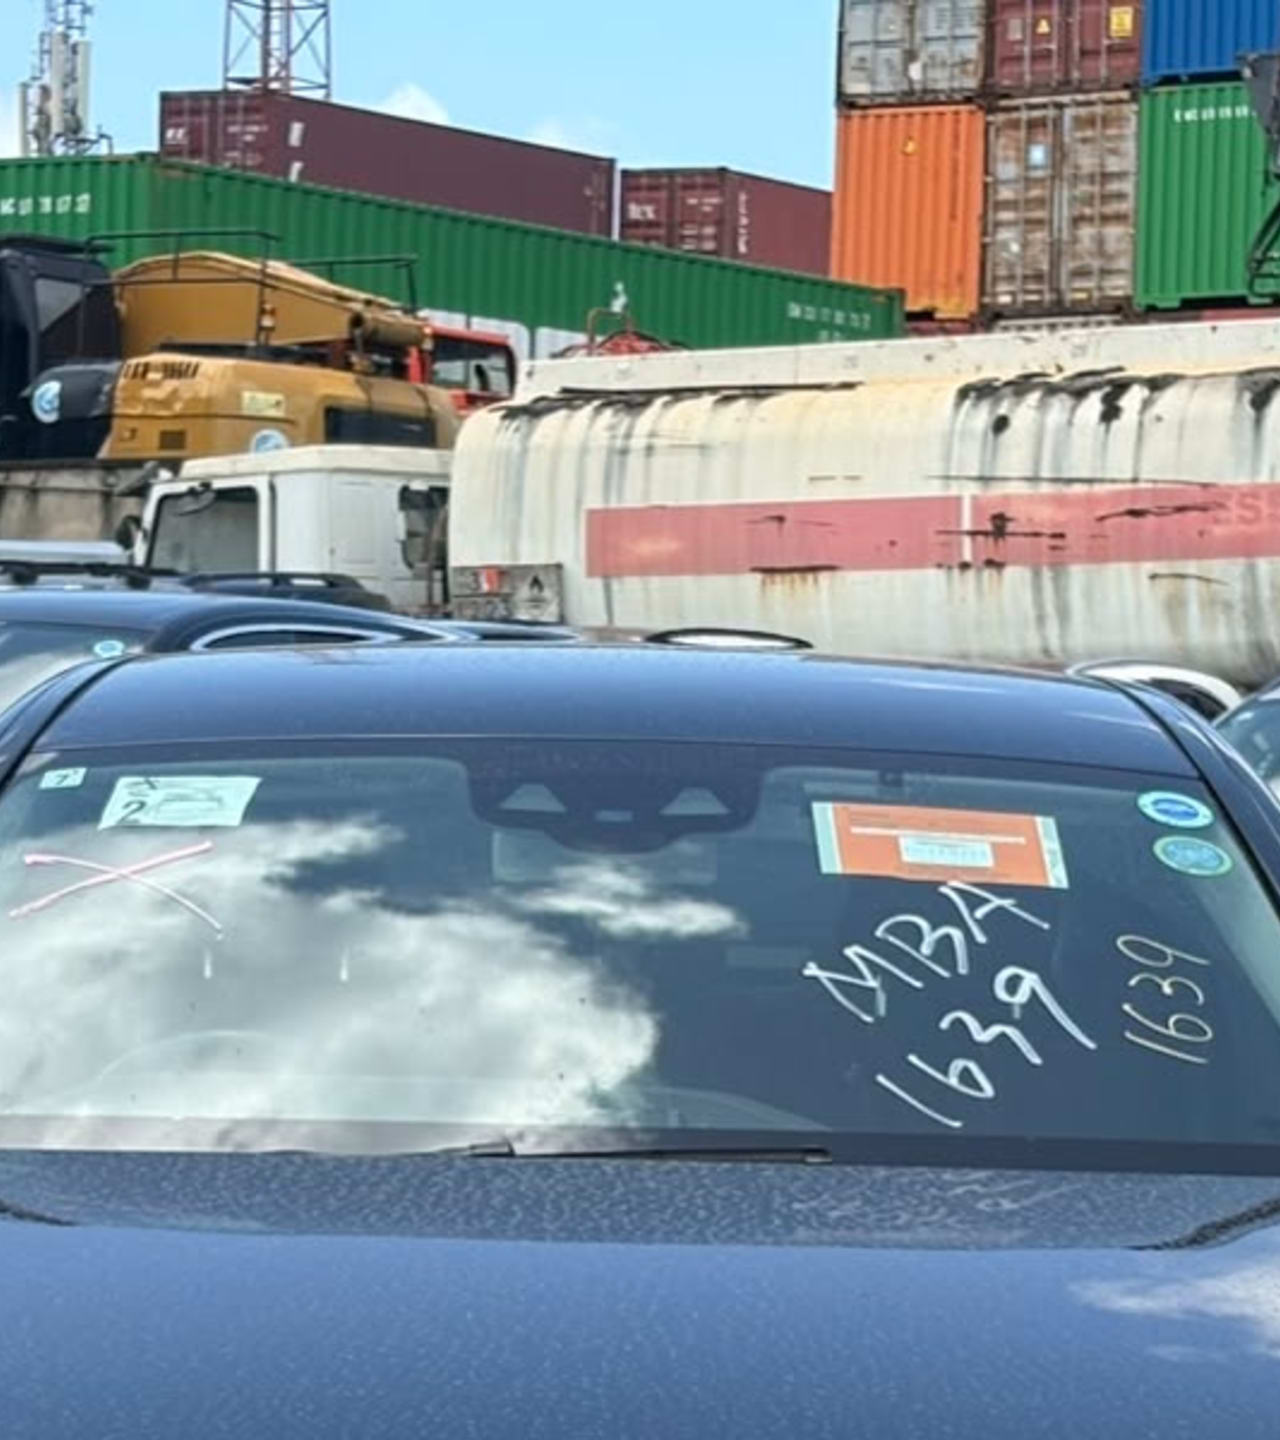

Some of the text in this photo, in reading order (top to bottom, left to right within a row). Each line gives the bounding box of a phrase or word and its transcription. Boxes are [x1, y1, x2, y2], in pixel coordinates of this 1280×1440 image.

[802, 880, 1050, 1024] MBA
[1116, 934, 1213, 1065] 1639
[875, 965, 1098, 1128] 1639
